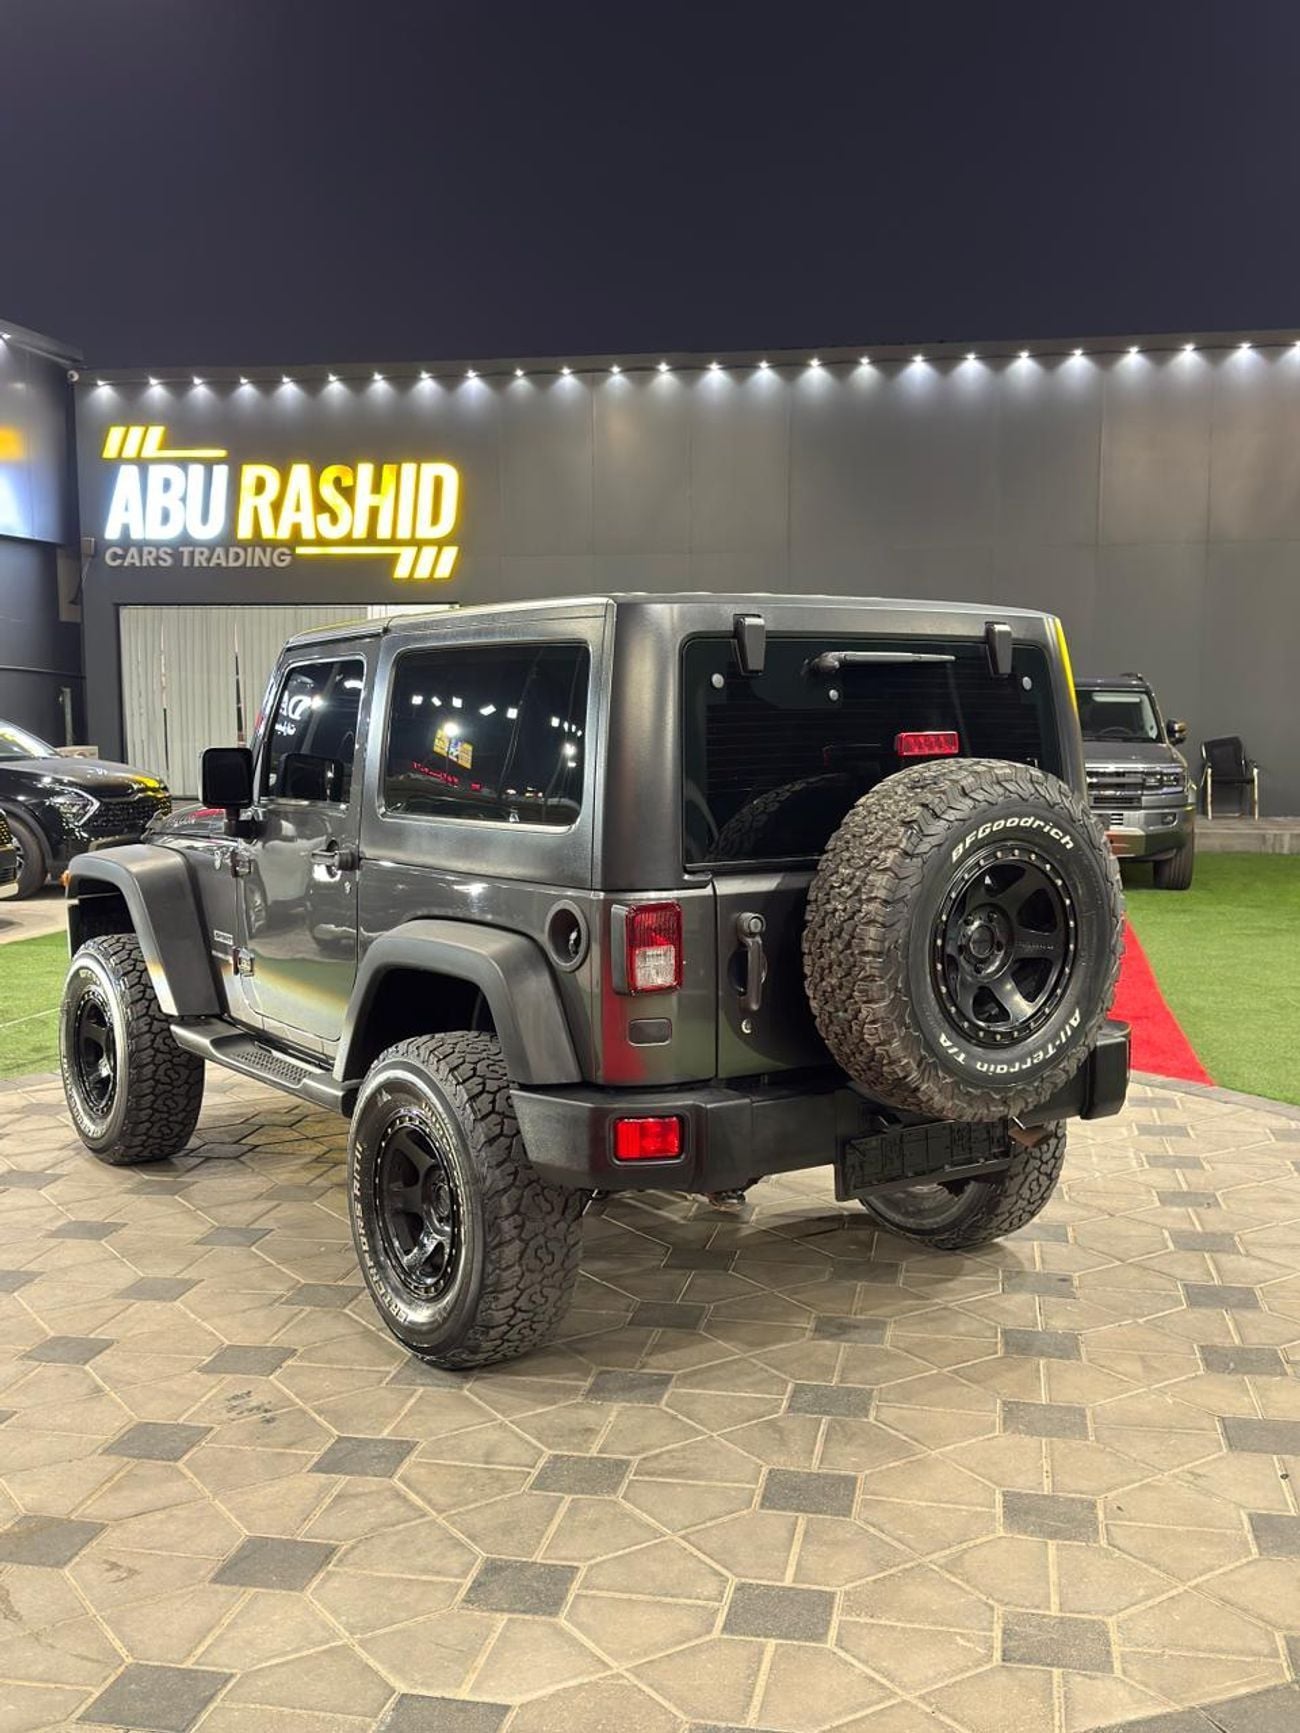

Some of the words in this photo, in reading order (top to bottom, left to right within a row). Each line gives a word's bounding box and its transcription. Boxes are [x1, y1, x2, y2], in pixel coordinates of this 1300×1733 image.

[104, 464, 229, 540] ABU
[237, 462, 460, 540] RASHID
[104, 546, 173, 568] CARS
[178, 546, 293, 568] TRADING
[951, 816, 1075, 863] BFGoodrich
[939, 1032, 967, 1064] T/A
[976, 1007, 1081, 1075] All-Terrain
